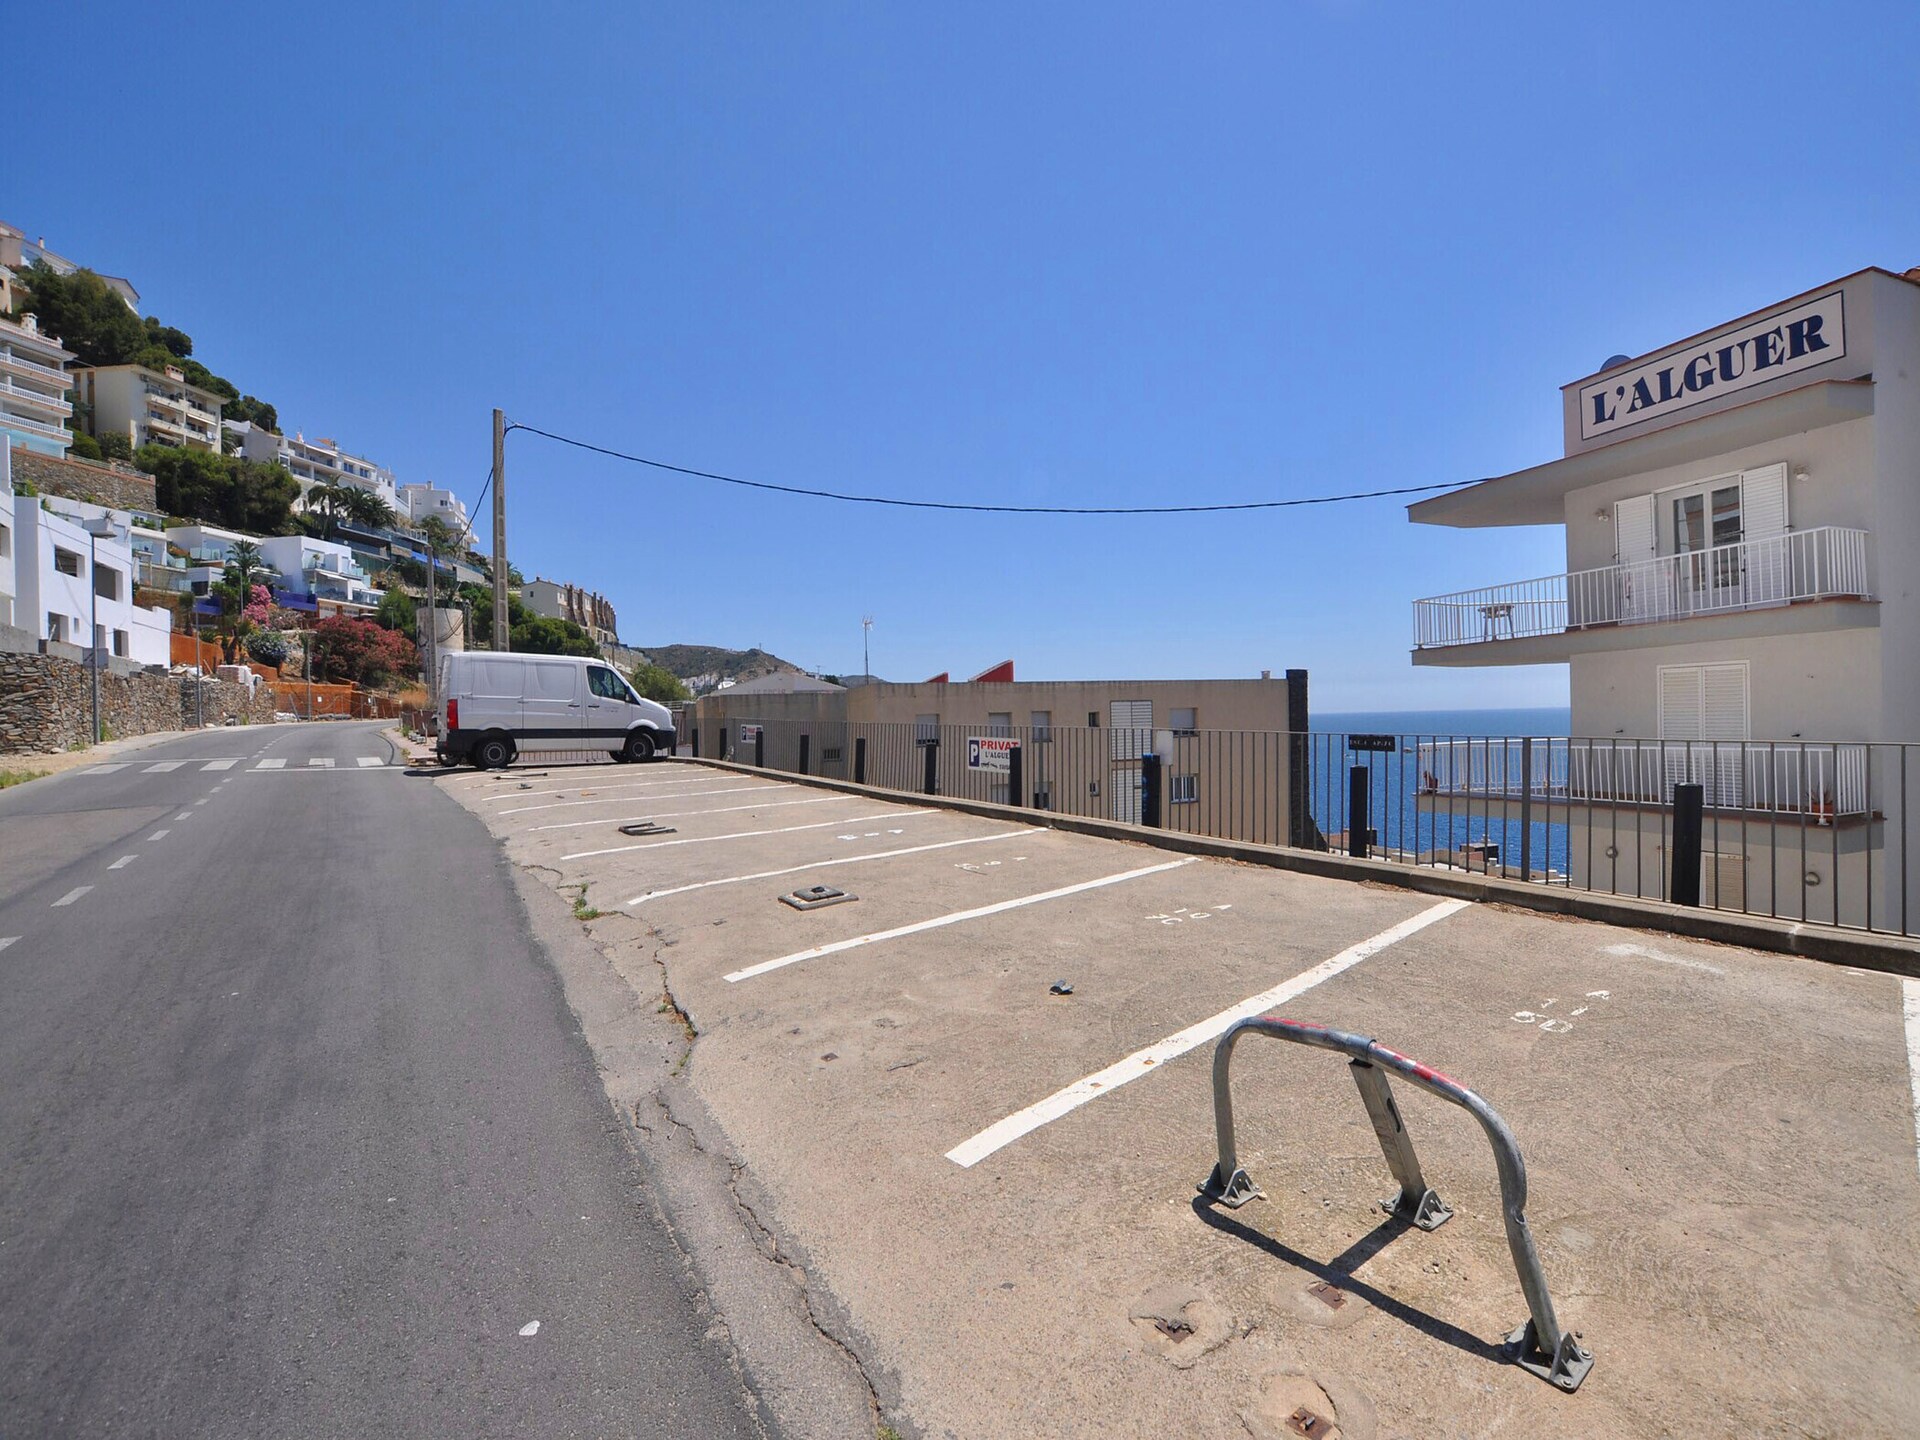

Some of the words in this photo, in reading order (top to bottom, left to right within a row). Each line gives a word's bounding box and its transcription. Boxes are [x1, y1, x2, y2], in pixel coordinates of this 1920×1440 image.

[1592, 314, 1830, 425] L'ALGUER
[970, 743, 979, 763] P
[981, 740, 1019, 751] PRIVAT
[985, 750, 1010, 760] L'ALGUE
